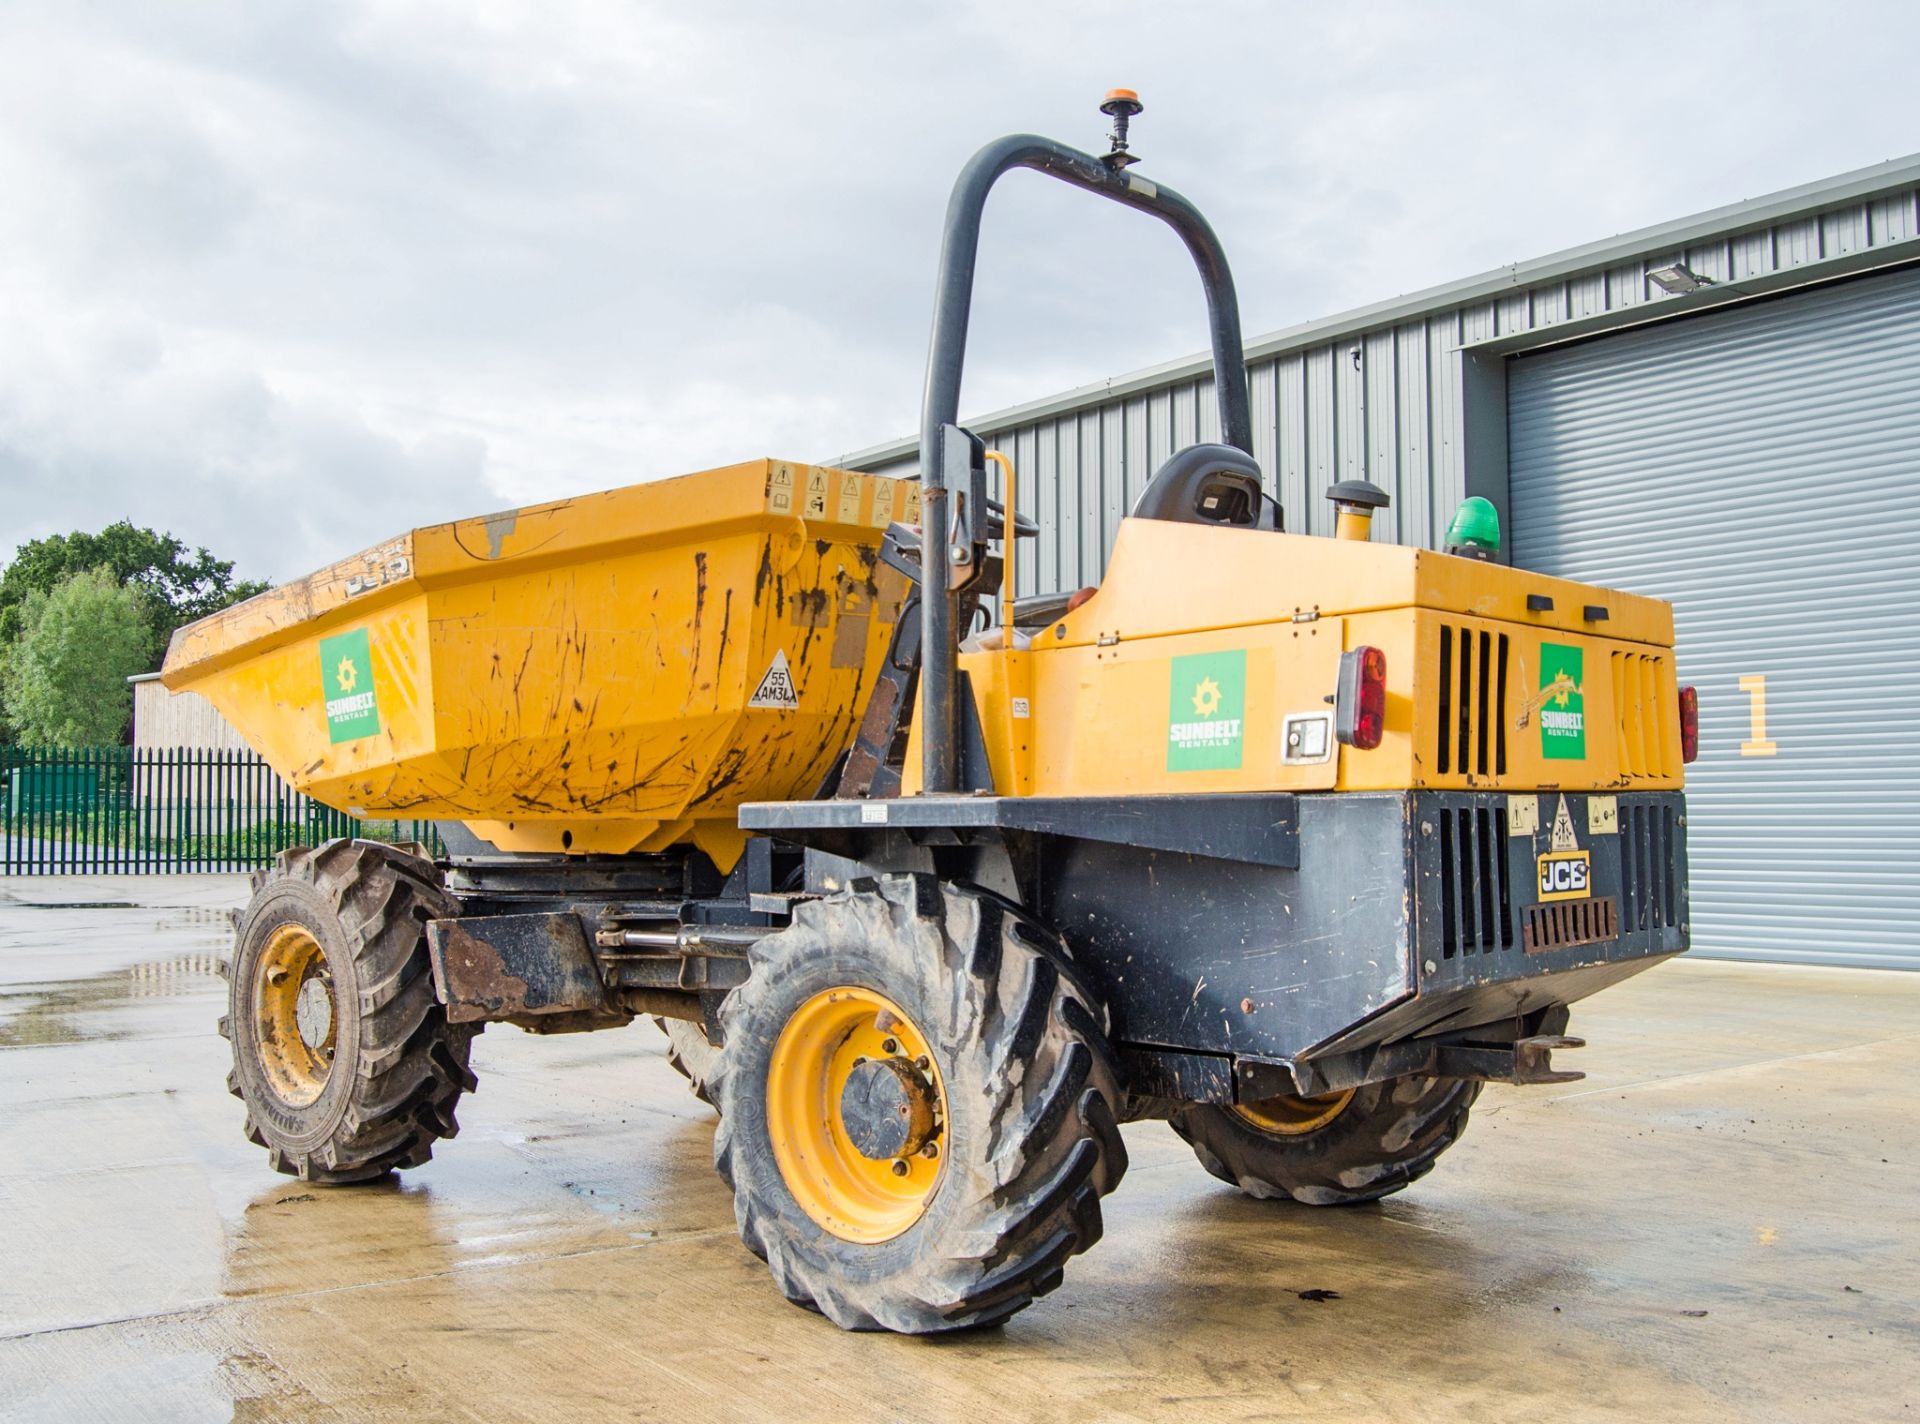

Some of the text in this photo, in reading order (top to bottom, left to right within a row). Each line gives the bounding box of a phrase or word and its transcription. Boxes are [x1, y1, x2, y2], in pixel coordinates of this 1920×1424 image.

[771, 672, 785, 686] 55
[326, 692, 374, 718] SUNBELT
[334, 709, 369, 723] RENTALS
[1541, 711, 1583, 730] SUNBELT
[1739, 675, 1777, 756] 1
[1170, 719, 1241, 742] SUNBELT
[1547, 729, 1578, 737] RENTALS
[1178, 738, 1230, 749] RENTALS
[1542, 861, 1586, 891] JCB
